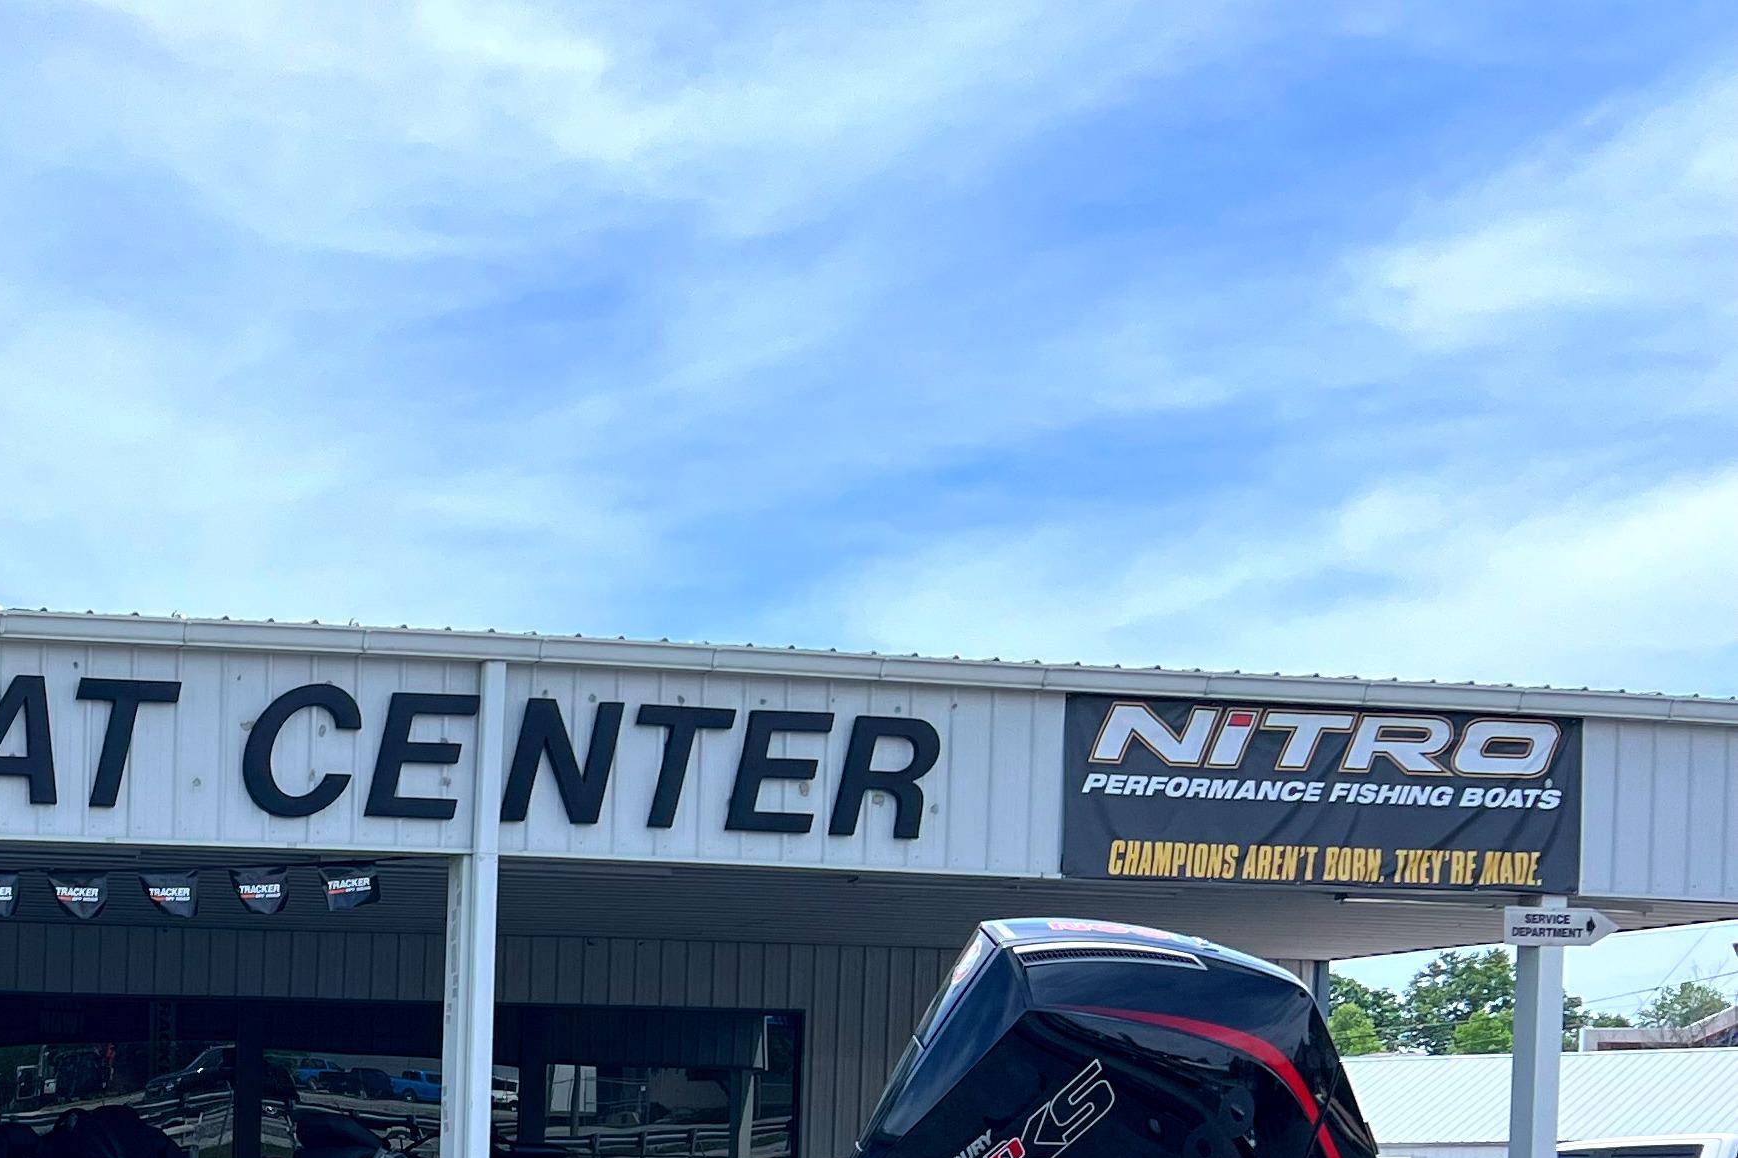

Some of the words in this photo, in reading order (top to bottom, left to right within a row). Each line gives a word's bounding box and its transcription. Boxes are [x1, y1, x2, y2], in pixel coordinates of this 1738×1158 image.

[1088, 701, 1562, 779] NITRO
[242, 683, 941, 839] CENTER
[1081, 773, 1325, 803] PERFORMANCE
[1328, 782, 1455, 807] FISHING
[1459, 787, 1563, 810] BOATS
[1108, 839, 1239, 880] CHAMPIONS
[1241, 844, 1319, 881] AREN'T
[1322, 846, 1385, 883] BORN.
[1394, 849, 1478, 886] THEY'RE
[1478, 851, 1543, 886] MADE.
[239, 883, 280, 894] TRACKER
[327, 877, 370, 890] TRACKER
[56, 886, 99, 897] TRACKER
[149, 887, 190, 897] TRACKER
[1525, 913, 1571, 924] SERVICE
[1512, 926, 1583, 938] DEPARTMENT
